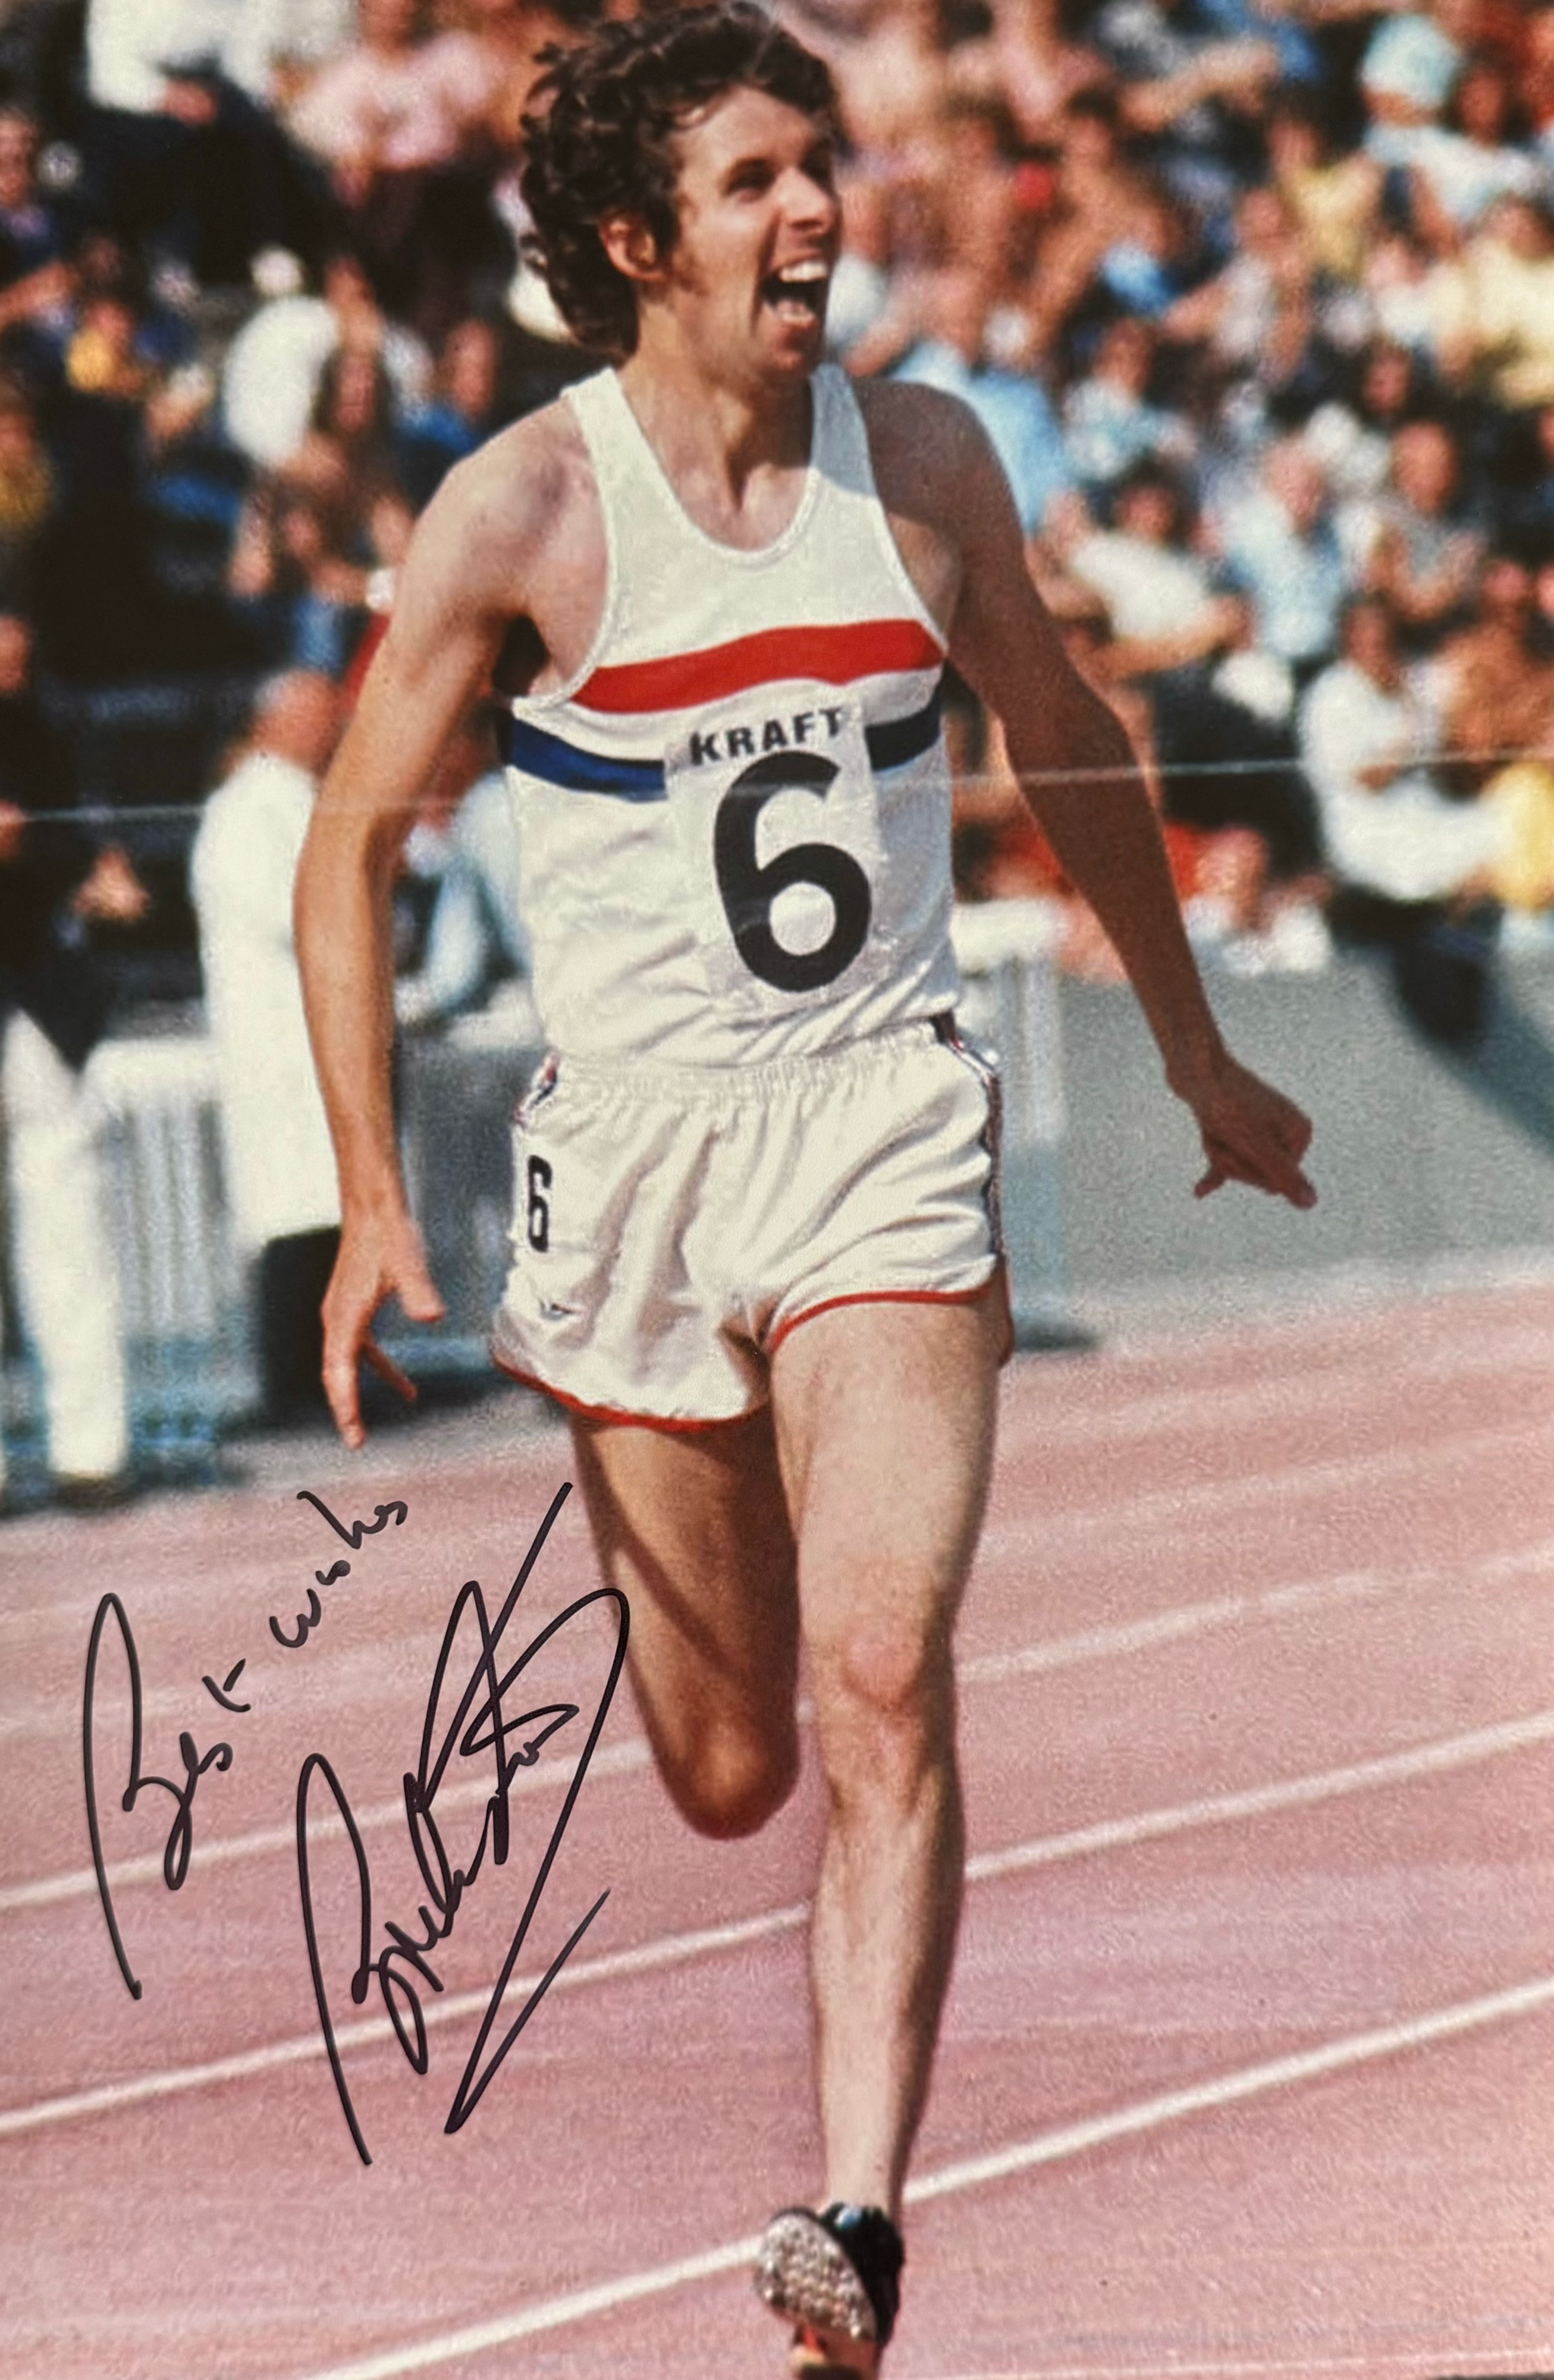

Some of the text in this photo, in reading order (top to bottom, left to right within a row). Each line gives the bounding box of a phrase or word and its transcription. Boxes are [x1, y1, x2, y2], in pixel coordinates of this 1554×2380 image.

[689, 708, 842, 766] KRAFT
[713, 749, 872, 992] 6
[528, 1154, 552, 1253] 6
